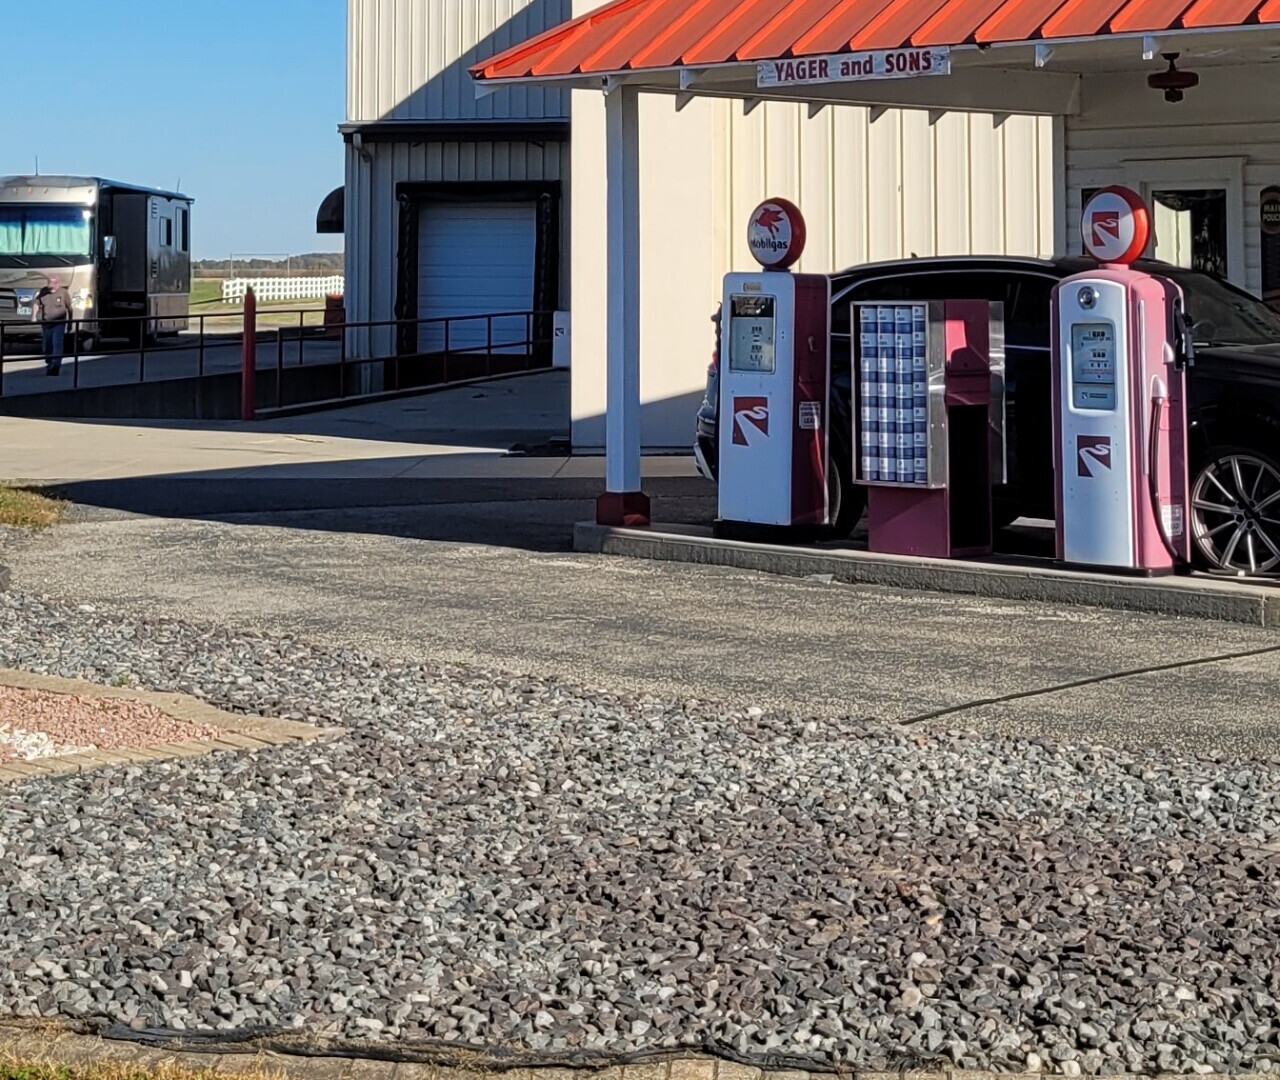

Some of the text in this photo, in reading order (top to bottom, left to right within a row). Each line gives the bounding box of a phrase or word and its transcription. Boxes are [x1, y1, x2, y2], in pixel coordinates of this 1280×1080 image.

[775, 50, 932, 82] YAGER and SONS
